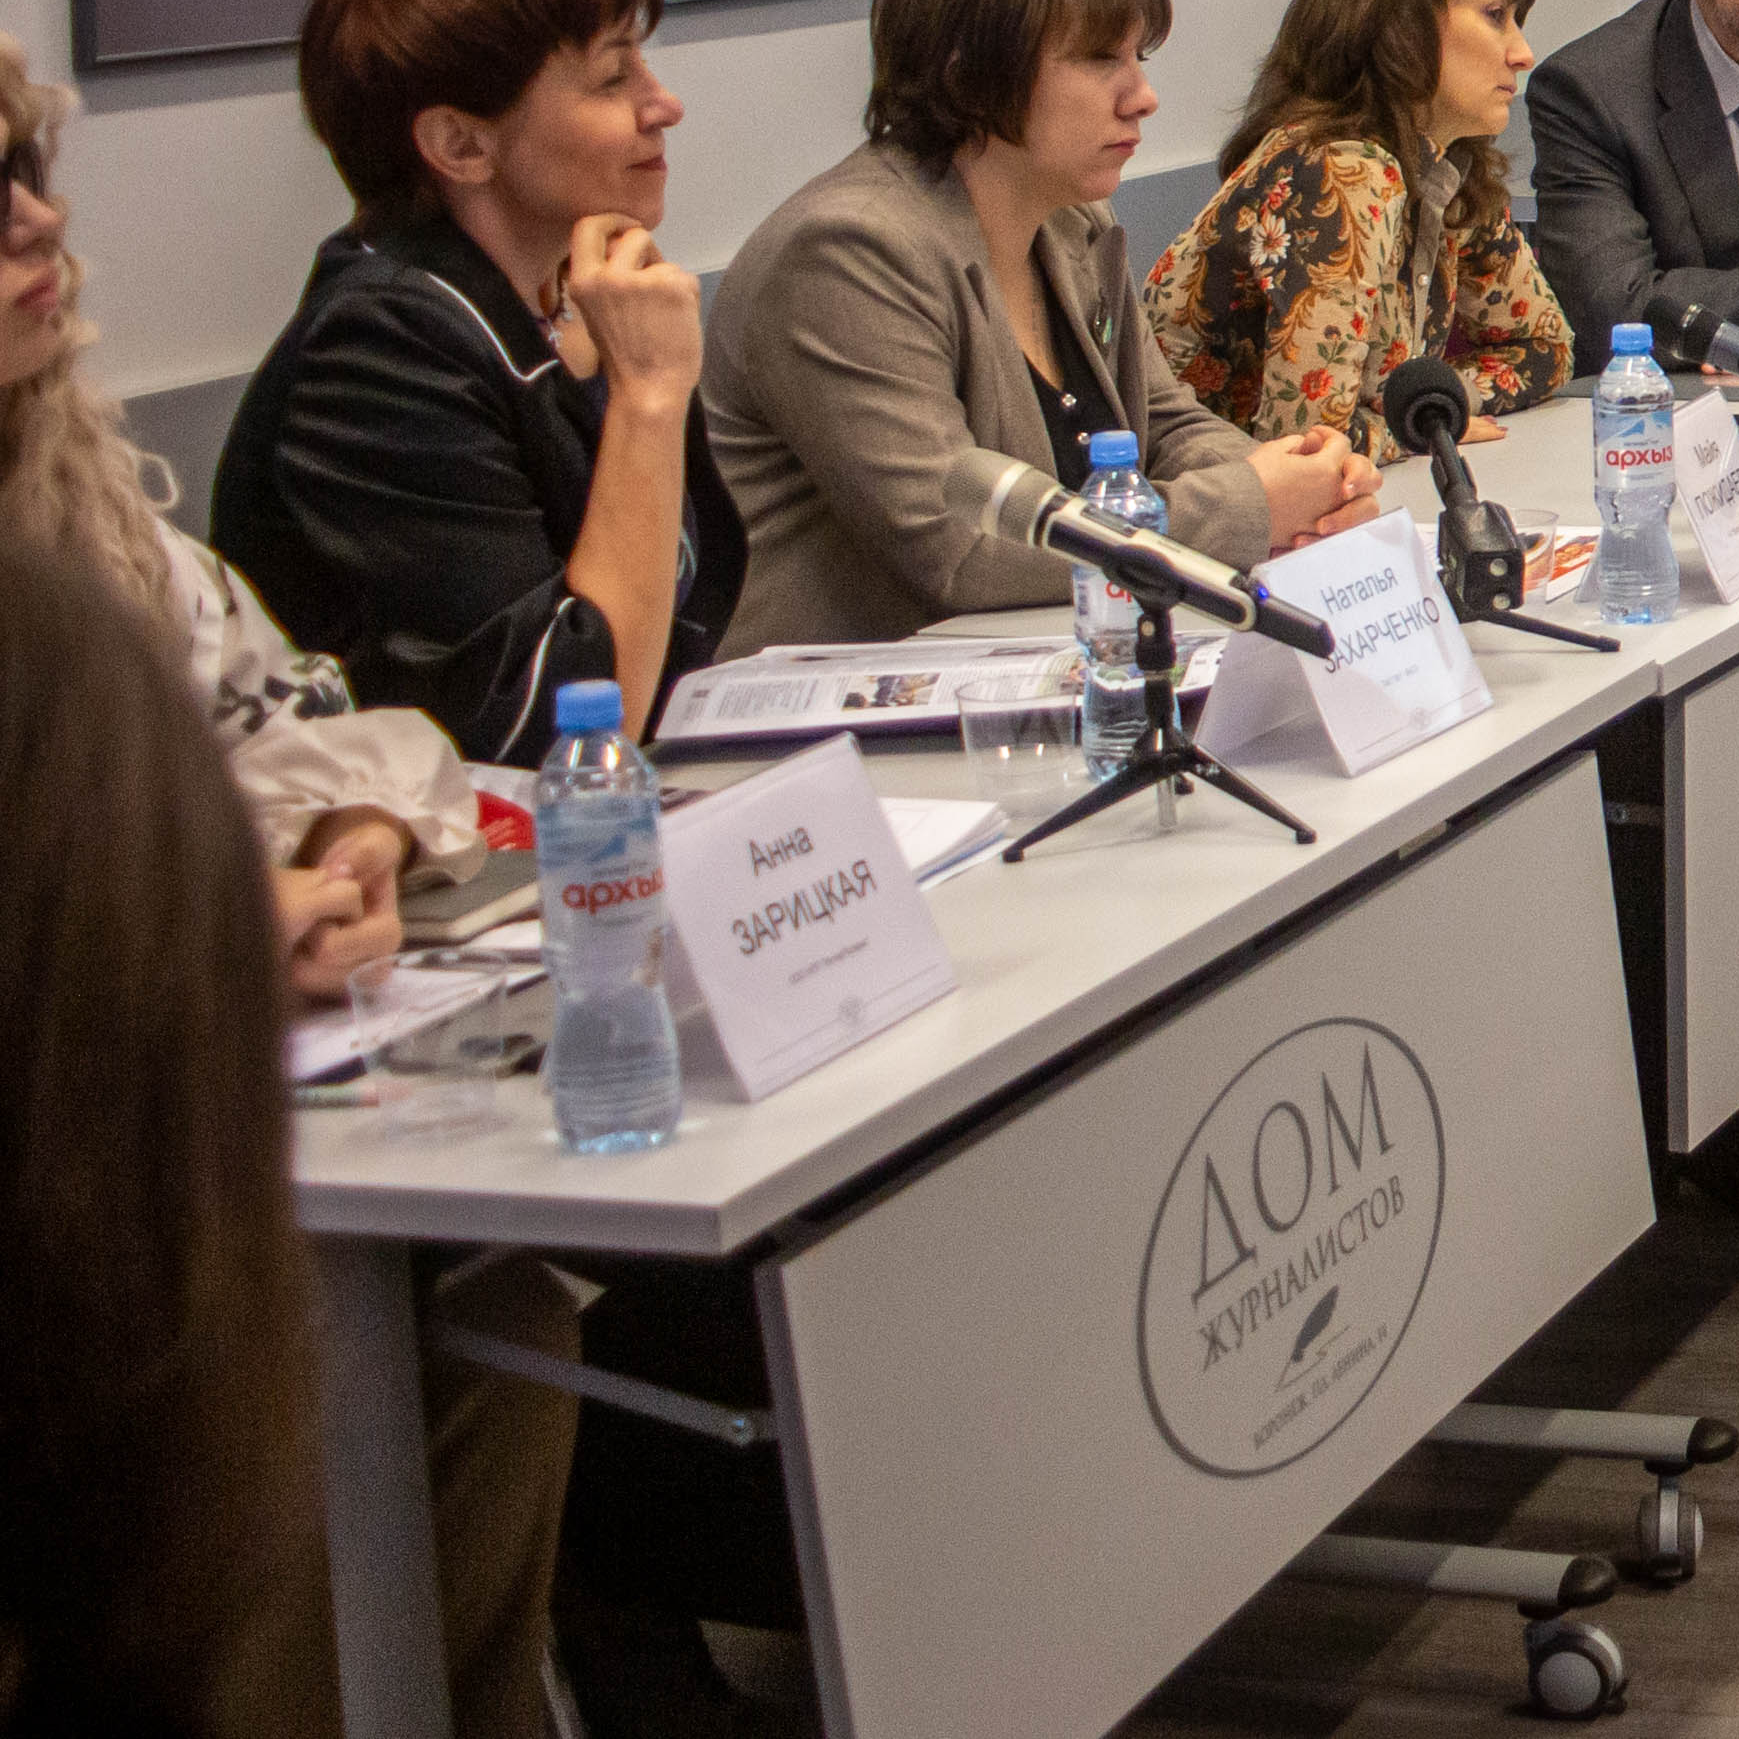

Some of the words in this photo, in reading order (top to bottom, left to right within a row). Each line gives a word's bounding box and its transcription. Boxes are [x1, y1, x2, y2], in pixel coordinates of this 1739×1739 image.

[1320, 567, 1400, 616] Наталья
[748, 827, 814, 877] Анна
[731, 859, 878, 956] ЗАРИЦКАЯ
[1191, 1042, 1395, 1312] ДОМ
[1199, 1175, 1405, 1372] ЖУРНАЛИСТОВ
